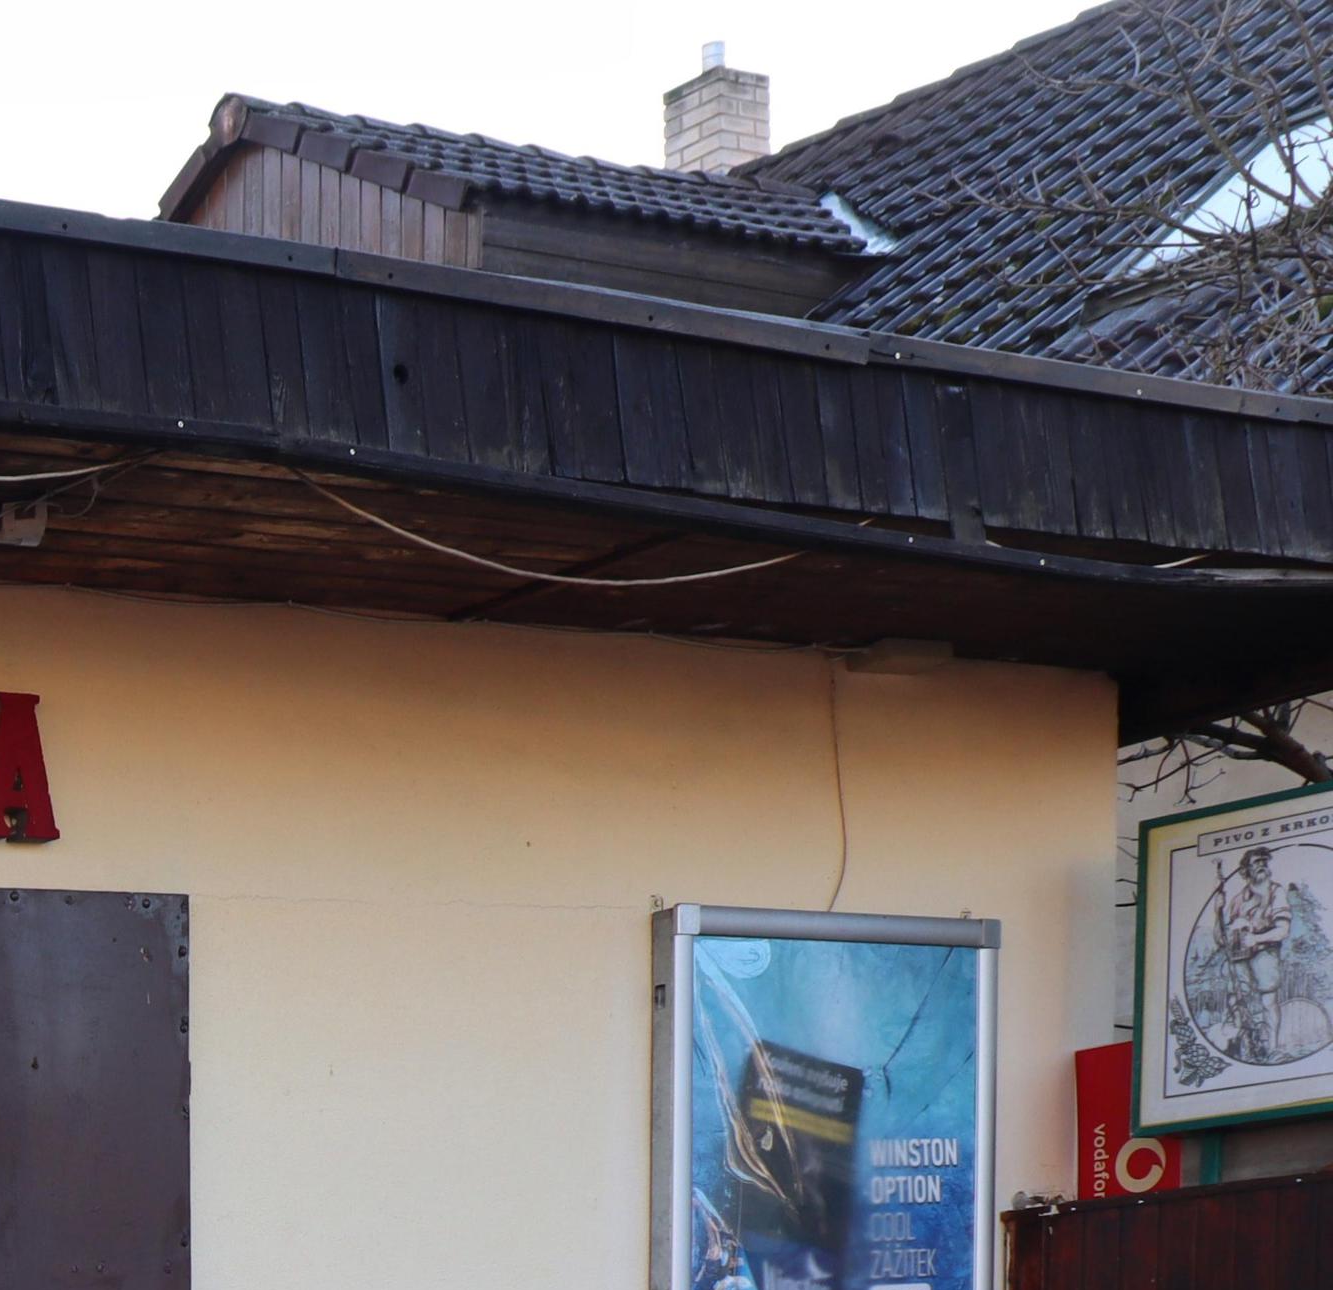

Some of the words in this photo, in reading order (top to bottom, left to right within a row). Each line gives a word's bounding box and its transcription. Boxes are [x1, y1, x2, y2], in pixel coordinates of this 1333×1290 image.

[1214, 831, 1254, 847] PIVO
[1261, 828, 1270, 837] Z
[1280, 814, 1333, 833] KRKO
[870, 1138, 958, 1167] WINSTON
[1093, 1123, 1109, 1198] vodafo
[871, 1175, 942, 1204] OPTION
[871, 1211, 916, 1241] COOL
[870, 1243, 938, 1279] ZÁŽITEK
